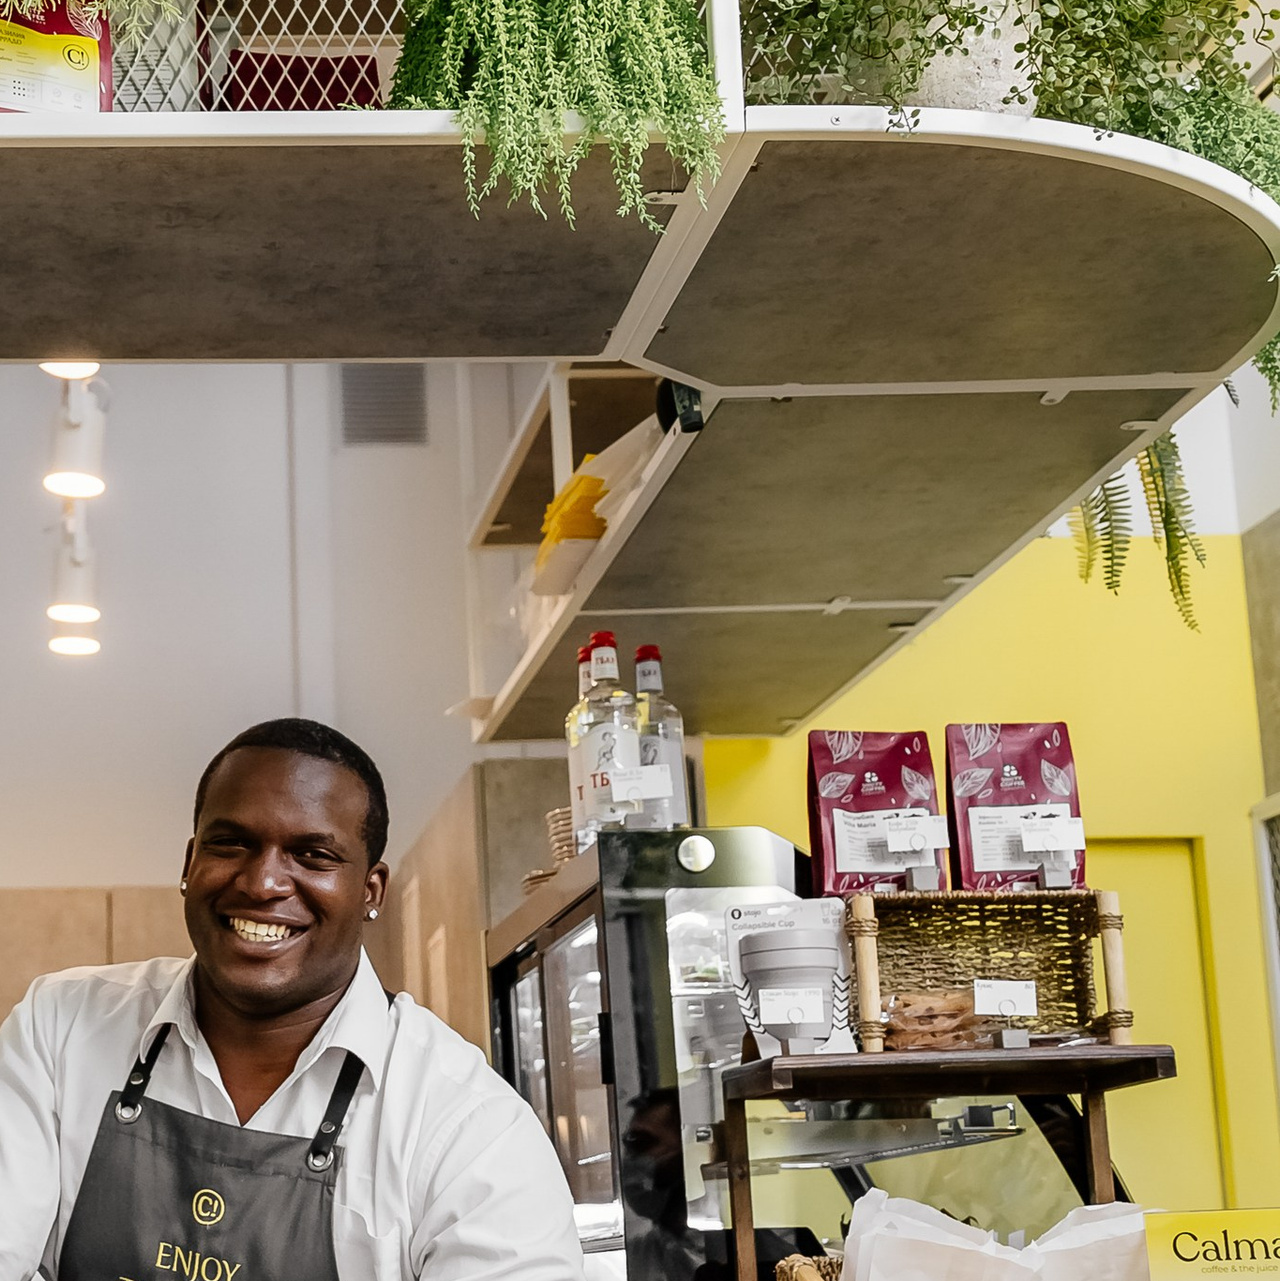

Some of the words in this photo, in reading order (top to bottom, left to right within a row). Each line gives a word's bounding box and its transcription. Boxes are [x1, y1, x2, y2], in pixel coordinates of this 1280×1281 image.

[67, 49, 86, 67] C!
[731, 922, 776, 931] Collapsible
[778, 920, 795, 929] Cup
[197, 1196, 219, 1218] C!
[1201, 1265, 1228, 1274] coffee
[1256, 1265, 1279, 1274] juice
